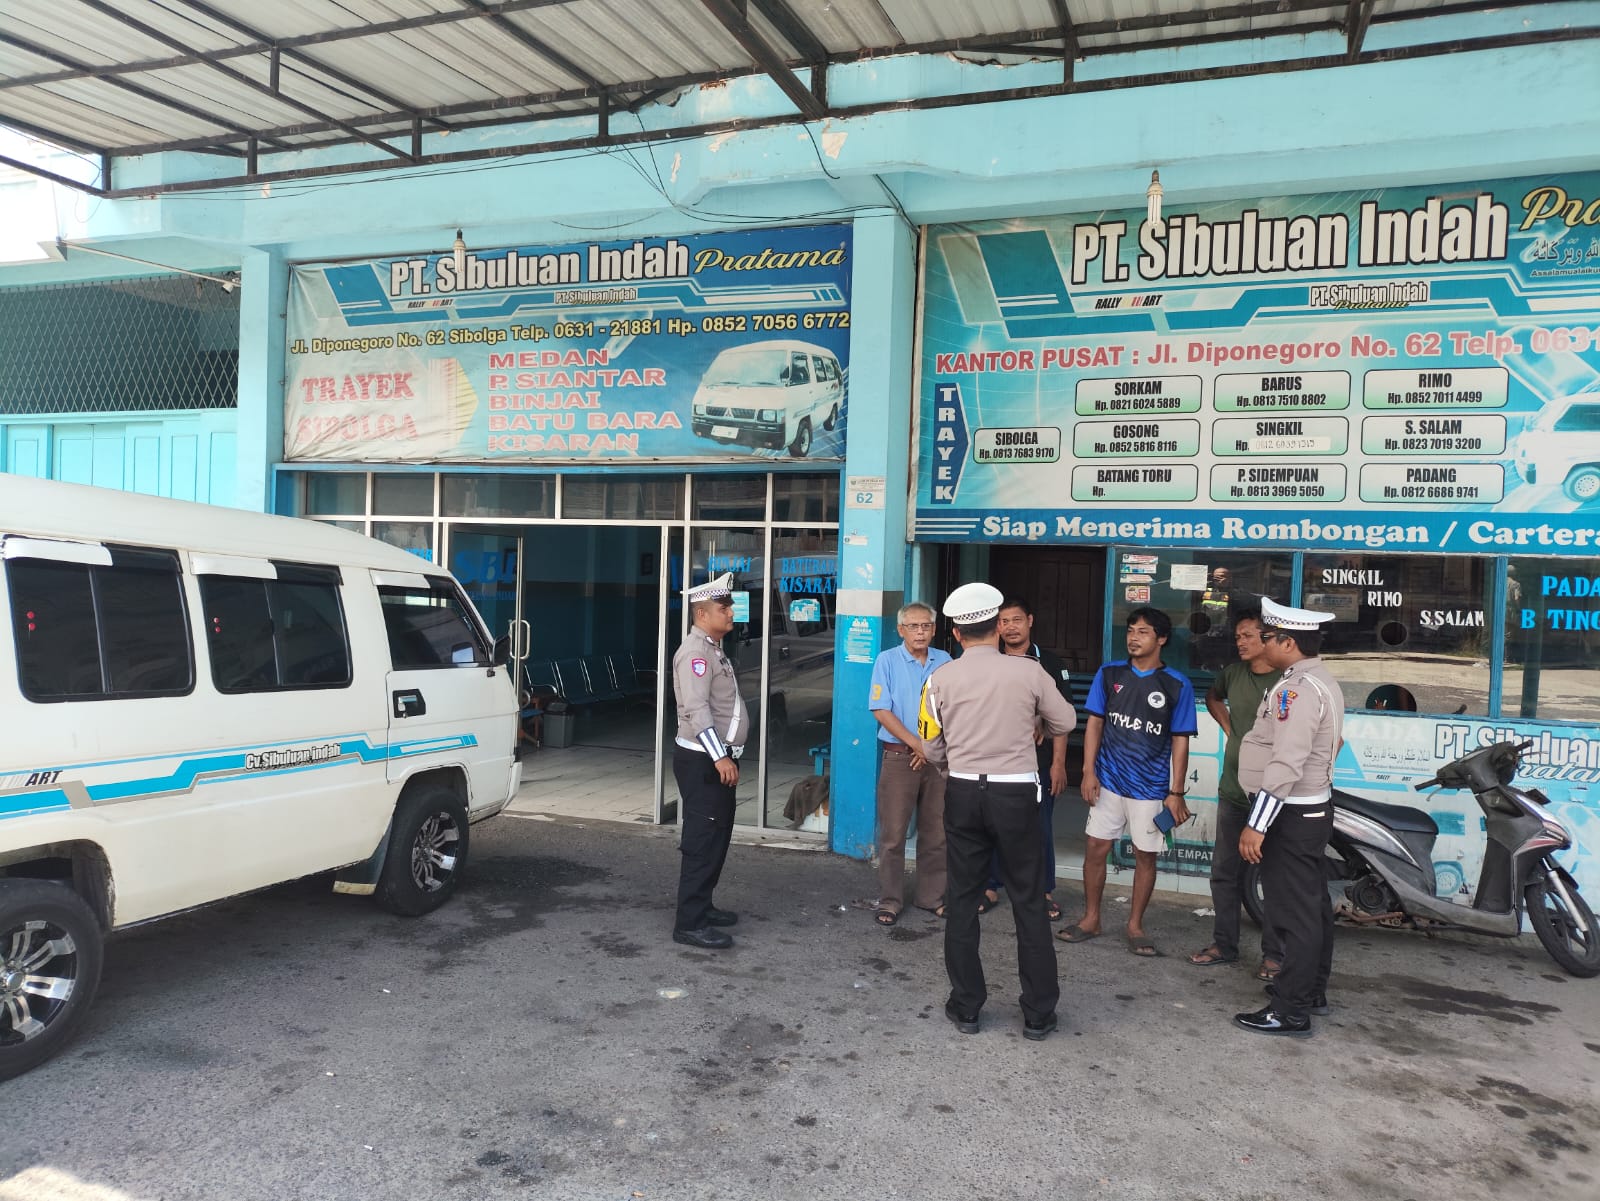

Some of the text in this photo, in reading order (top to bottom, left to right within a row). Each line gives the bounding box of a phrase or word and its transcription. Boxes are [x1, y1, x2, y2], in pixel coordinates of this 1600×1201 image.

[1071, 220, 1129, 286] PT.
[1137, 208, 1349, 280] Sibuluan
[1358, 192, 1509, 268] Indah
[390, 239, 847, 297] PT. Sibuluan Indah Pratama
[1310, 281, 1428, 307] PT. Sibuluan Indah
[1095, 295, 1163, 309] RALLY ART
[290, 339, 308, 354] Jl.
[312, 336, 394, 355] Diponegoro
[397, 332, 422, 347] No.
[426, 330, 445, 345] 62
[449, 326, 507, 345] Sibolga
[511, 324, 549, 342] Telp.
[554, 321, 594, 338] 0631
[610, 319, 661, 337] 21881
[667, 318, 697, 337] Hp.
[702, 315, 746, 333] 0852
[752, 313, 798, 331] 7056
[802, 311, 851, 329] 6772
[488, 348, 609, 370] MEDAN
[936, 349, 1034, 374] KANTOR
[1041, 345, 1125, 369] PUSAT
[1148, 343, 1178, 364] Jl.
[1187, 341, 1342, 367] Diponegoro
[1350, 336, 1396, 358] No.
[1405, 333, 1441, 356] 62
[1450, 329, 1522, 360] Telp.
[516, 367, 667, 389] SIANTAR
[1261, 376, 1303, 392] BARUS
[1418, 372, 1453, 388] RIMO
[301, 371, 415, 404] TRAYEK
[1114, 381, 1162, 396] SORKAM
[488, 391, 601, 411] BINJAI
[1095, 397, 1181, 411] Hp. 0821 6024 5889
[1236, 393, 1326, 408] Hp. 0813 7510 8802
[1387, 390, 1483, 405] Hp. 0852 7011 4499
[488, 411, 683, 431] BATU BARA
[1405, 419, 1462, 434] S. SALAM
[1113, 424, 1159, 439] GOSONG
[1256, 421, 1304, 437] SINGKIL
[488, 433, 639, 451] KISARAN
[934, 387, 957, 500] TRAYEK
[995, 432, 1038, 446] SIBOLGA
[1235, 440, 1250, 452] Hp.
[1385, 438, 1482, 452] Hp. 0823 7019 3200
[979, 448, 992, 459] Hp.
[1094, 440, 1178, 454] Hp. 0852 5816 8116
[1097, 469, 1172, 483] BATANG TORU
[1237, 468, 1319, 483] P. SIDEMPUAN
[1406, 468, 1457, 483] PADANG
[856, 492, 873, 504] 62
[1092, 486, 1106, 498] Hp.
[1230, 485, 1325, 498] Hp. 0813 3969 5050
[1384, 486, 1479, 499] Hp. 0812 6686 9741
[982, 516, 1047, 541] Siap
[1055, 517, 1212, 539] Menerima
[1221, 517, 1430, 547] Rombongan
[1438, 521, 1458, 547] /
[1322, 568, 1384, 586] SINGKIL
[1367, 590, 1403, 607] RIMO
[1520, 608, 1536, 629] B
[25, 770, 63, 786] ART
[1189, 769, 1199, 783] 4
